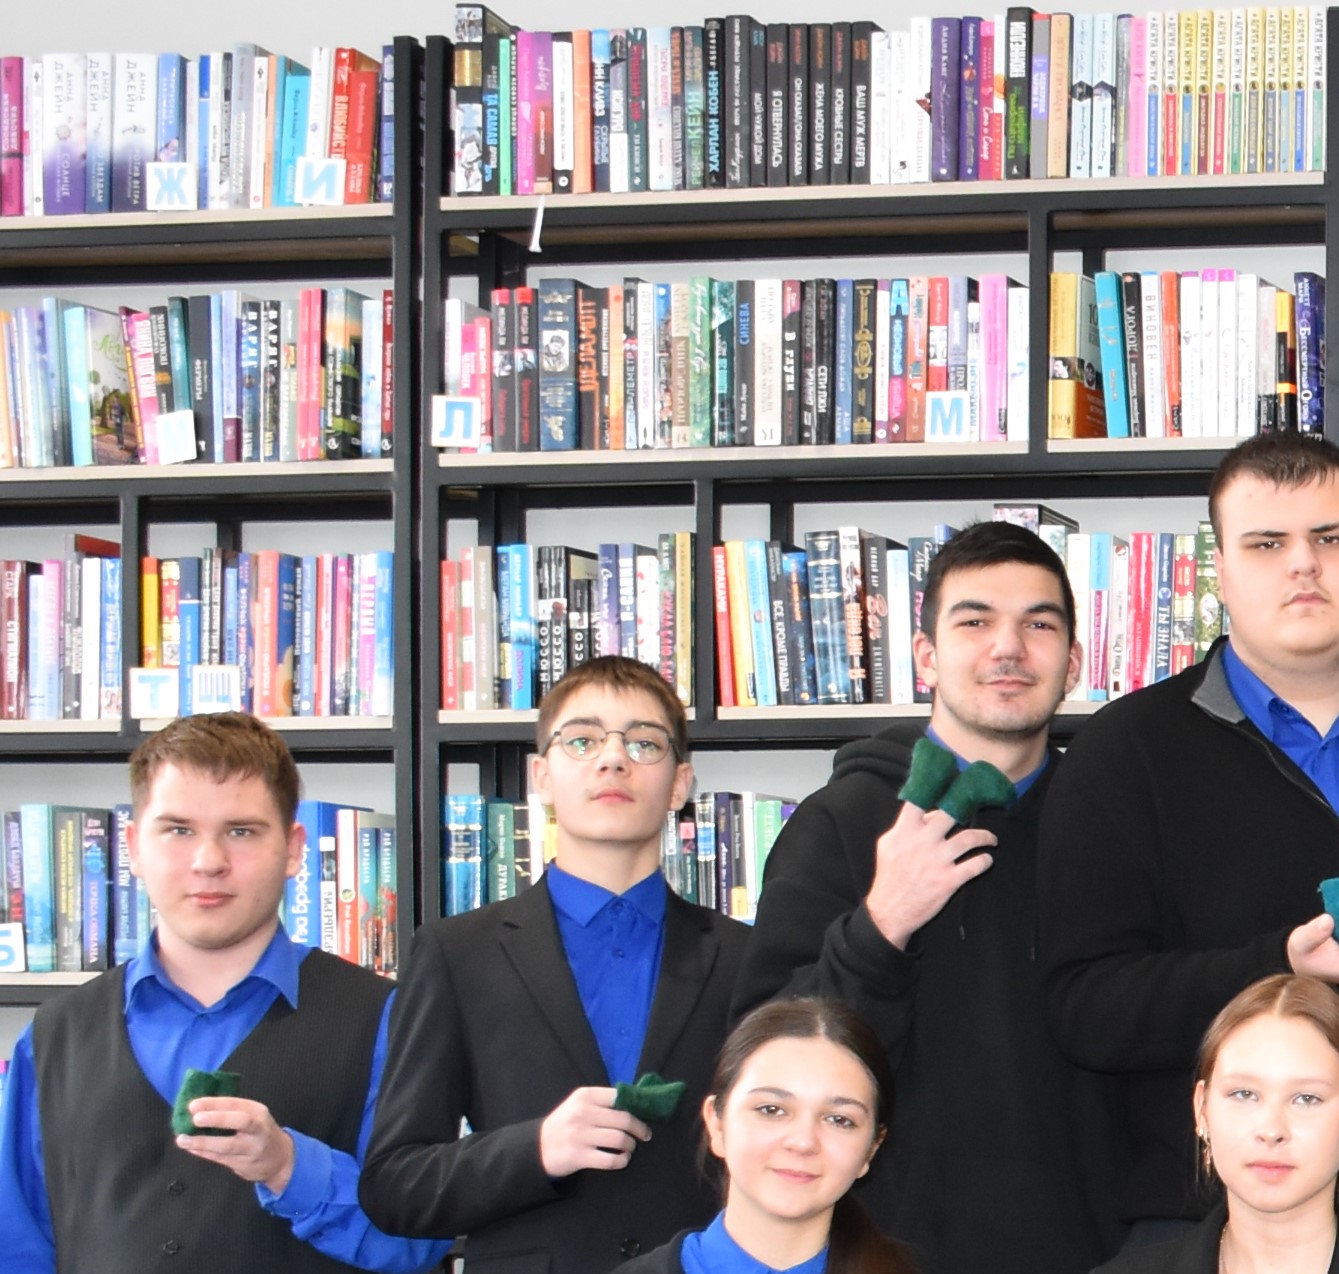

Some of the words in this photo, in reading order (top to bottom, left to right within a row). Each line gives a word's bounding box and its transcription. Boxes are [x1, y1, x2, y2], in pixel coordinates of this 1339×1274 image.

[53, 61, 66, 113] ДЖЕЙН
[89, 59, 99, 112] ДЖЕЙН
[126, 61, 137, 112] ДЖЕЙН
[708, 71, 720, 116] КОБЕН
[483, 107, 499, 145] САМАЯ
[708, 121, 720, 174] ХАРЛАН
[154, 167, 189, 204] Ж
[303, 165, 338, 199] И
[739, 303, 750, 346] СИНЕВА
[1127, 305, 1137, 352] ДОРОГА
[1145, 295, 1157, 360] ВИНОВЕН
[439, 402, 473, 439] Л
[930, 398, 961, 435] М
[714, 554, 727, 613] МУРАКАМИ
[1156, 604, 1170, 621] ТЫ
[540, 626, 549, 683] МЮССО
[553, 626, 563, 683] МЮССО
[1156, 622, 1170, 668] ЗНАЛА
[138, 675, 171, 711] Т
